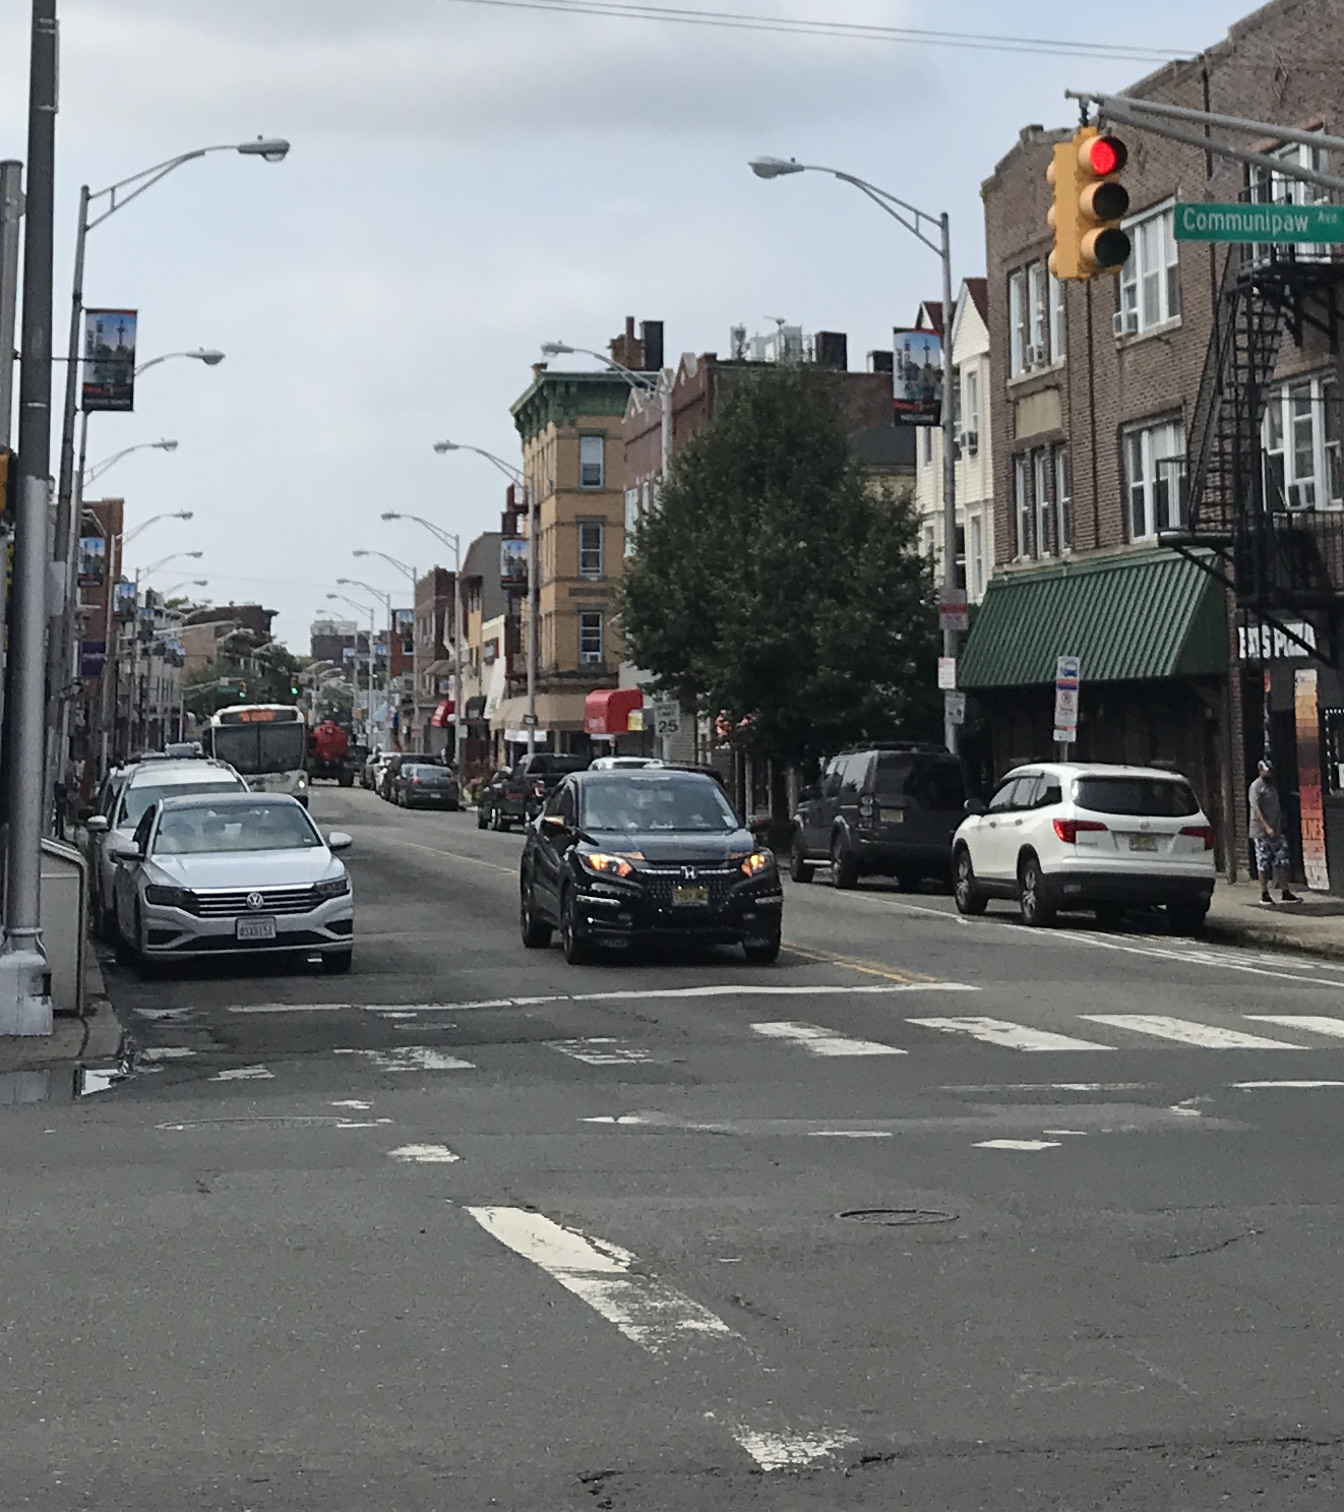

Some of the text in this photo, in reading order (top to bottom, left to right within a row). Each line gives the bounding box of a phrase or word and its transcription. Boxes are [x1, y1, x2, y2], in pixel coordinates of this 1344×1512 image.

[1183, 207, 1338, 236] Communipaw Ave
[658, 720, 678, 733] 25
